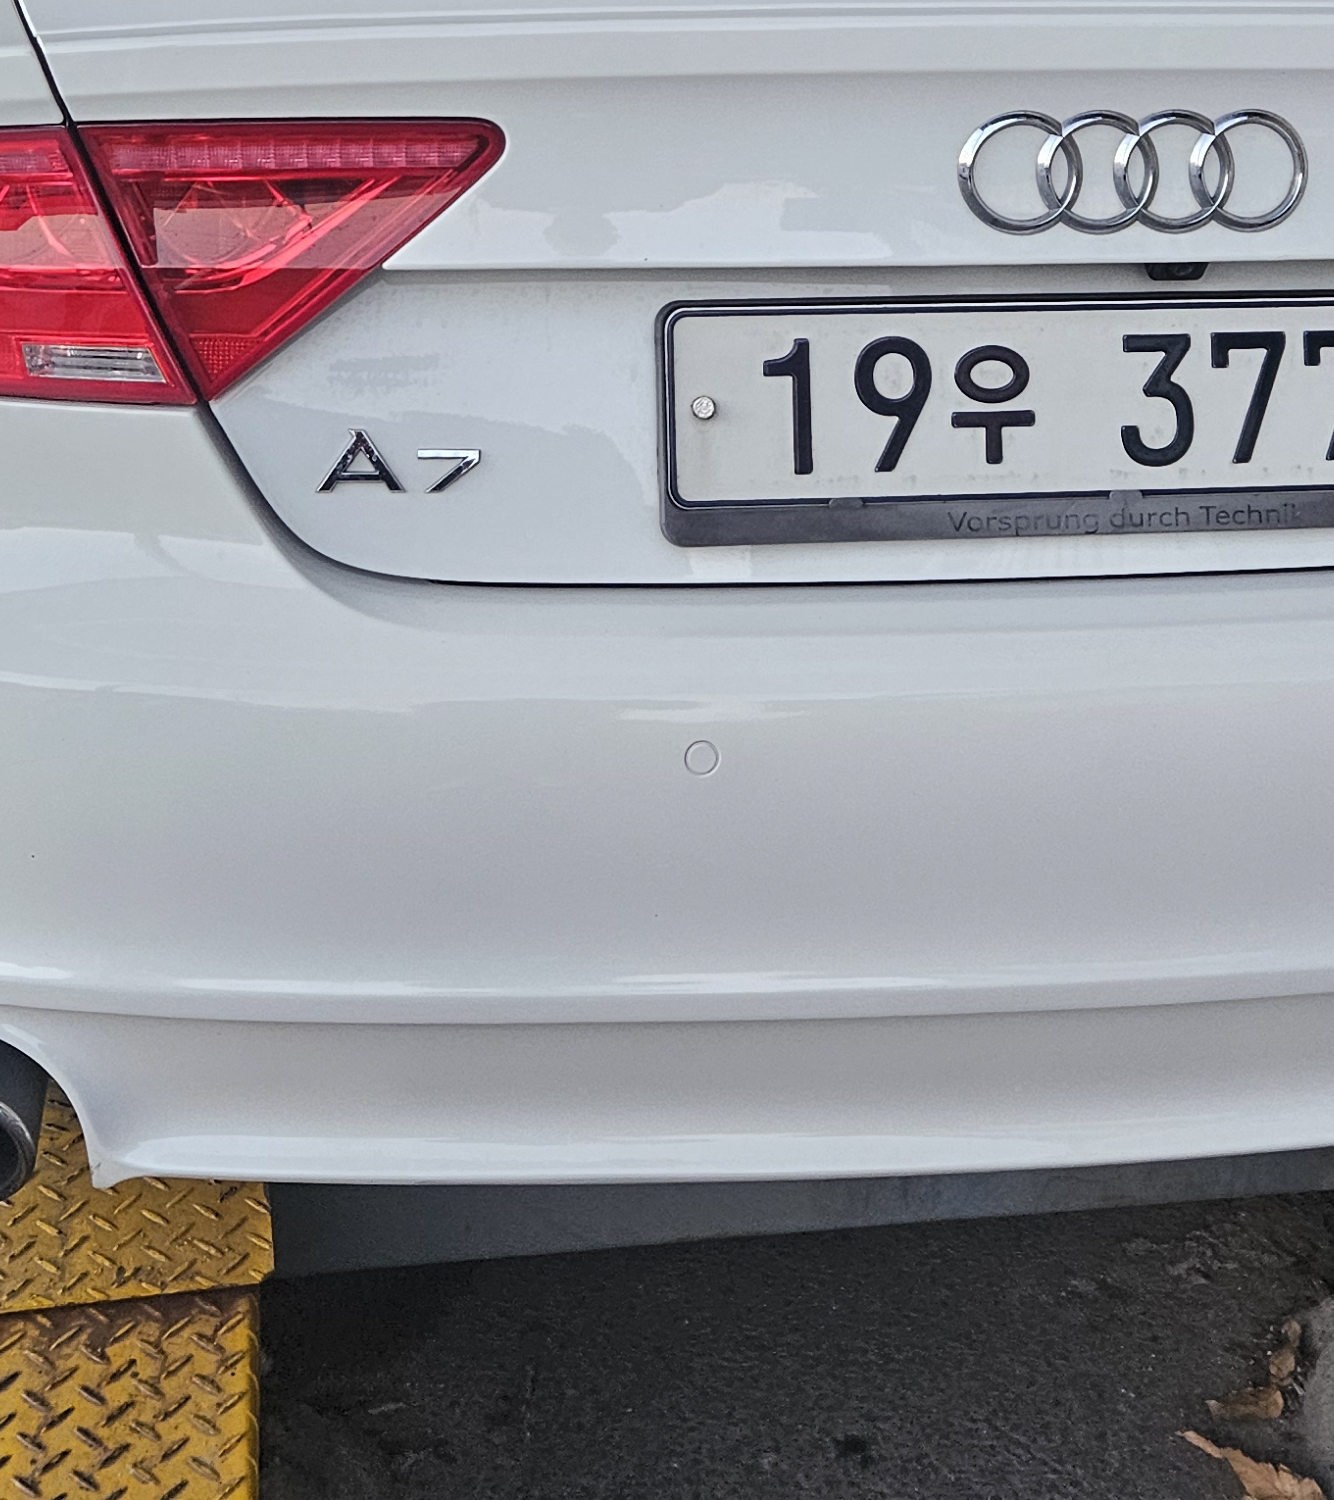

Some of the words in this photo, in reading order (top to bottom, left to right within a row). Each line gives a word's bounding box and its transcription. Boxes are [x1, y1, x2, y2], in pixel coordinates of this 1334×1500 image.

[761, 335, 1037, 476] 19우
[315, 427, 482, 494] A7
[947, 509, 1100, 536] Vorsprung
[1109, 503, 1191, 529] durch
